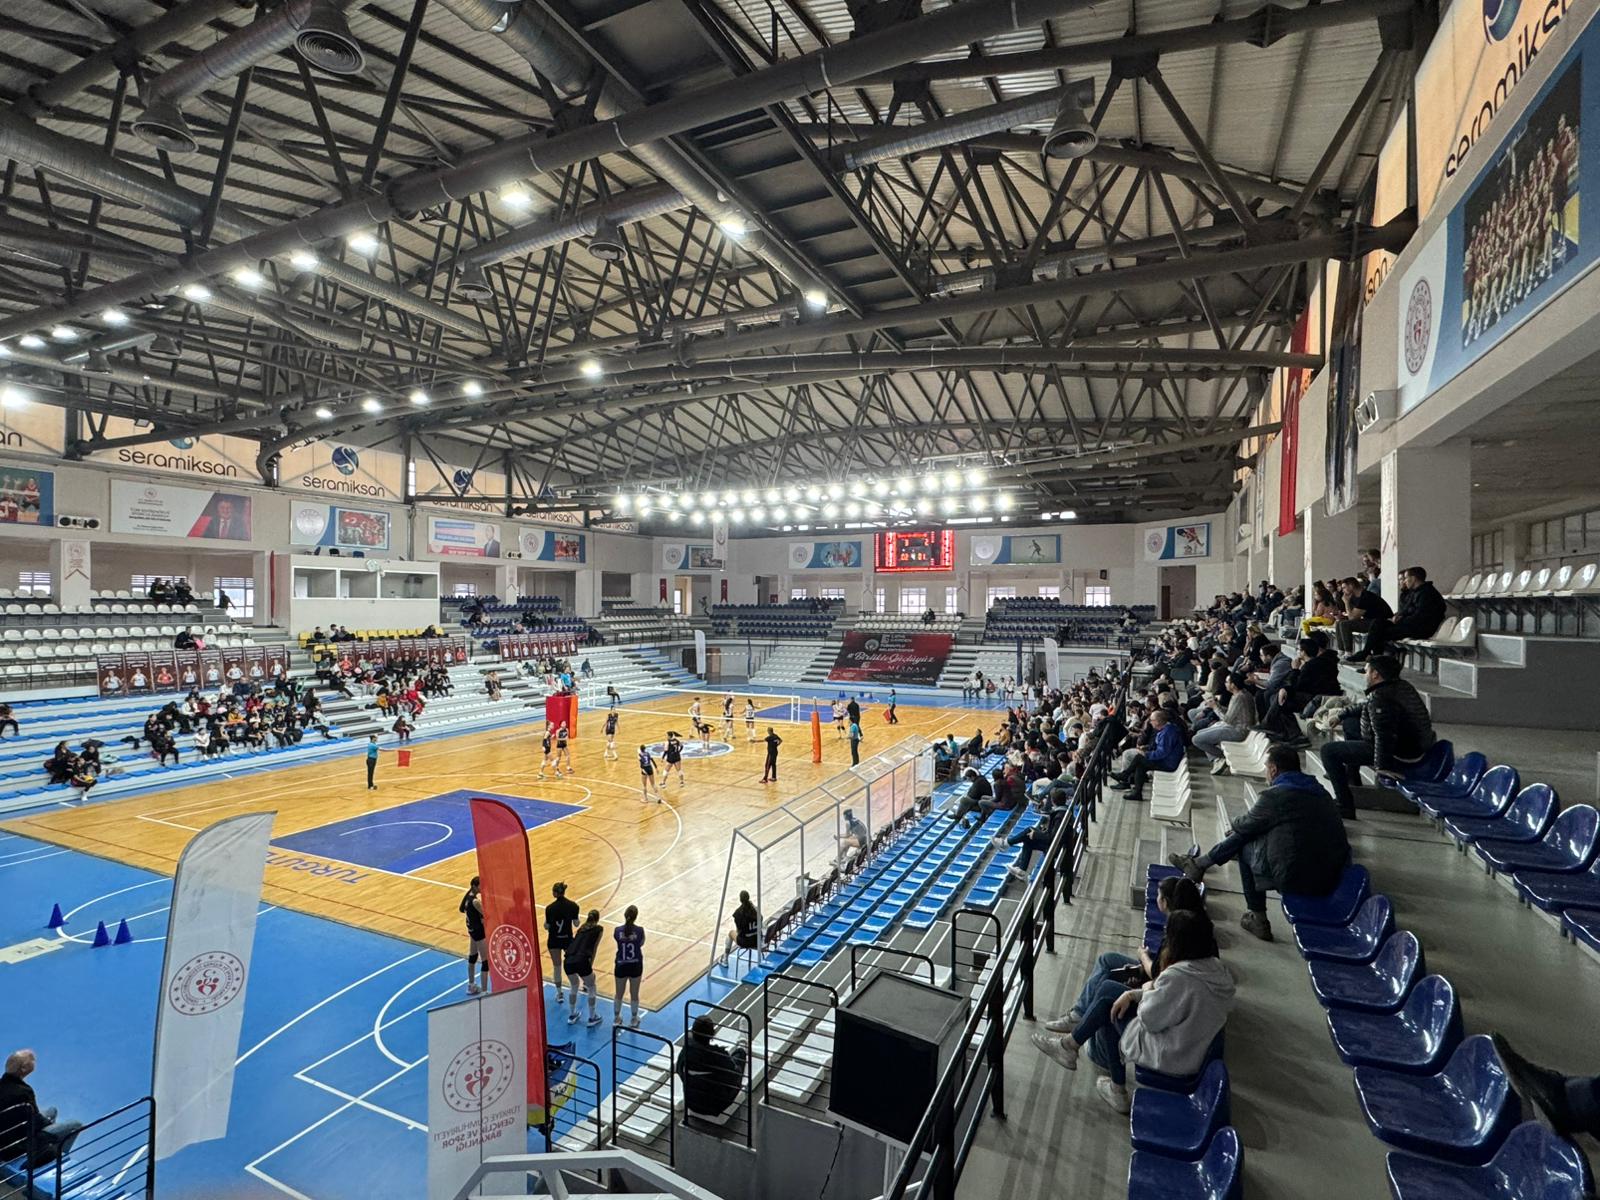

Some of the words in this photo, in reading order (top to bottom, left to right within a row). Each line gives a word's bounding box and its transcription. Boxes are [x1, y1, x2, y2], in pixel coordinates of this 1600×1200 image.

[118, 448, 237, 478] seramiksan
[302, 473, 386, 498] seramiksan
[621, 942, 636, 961] 13
